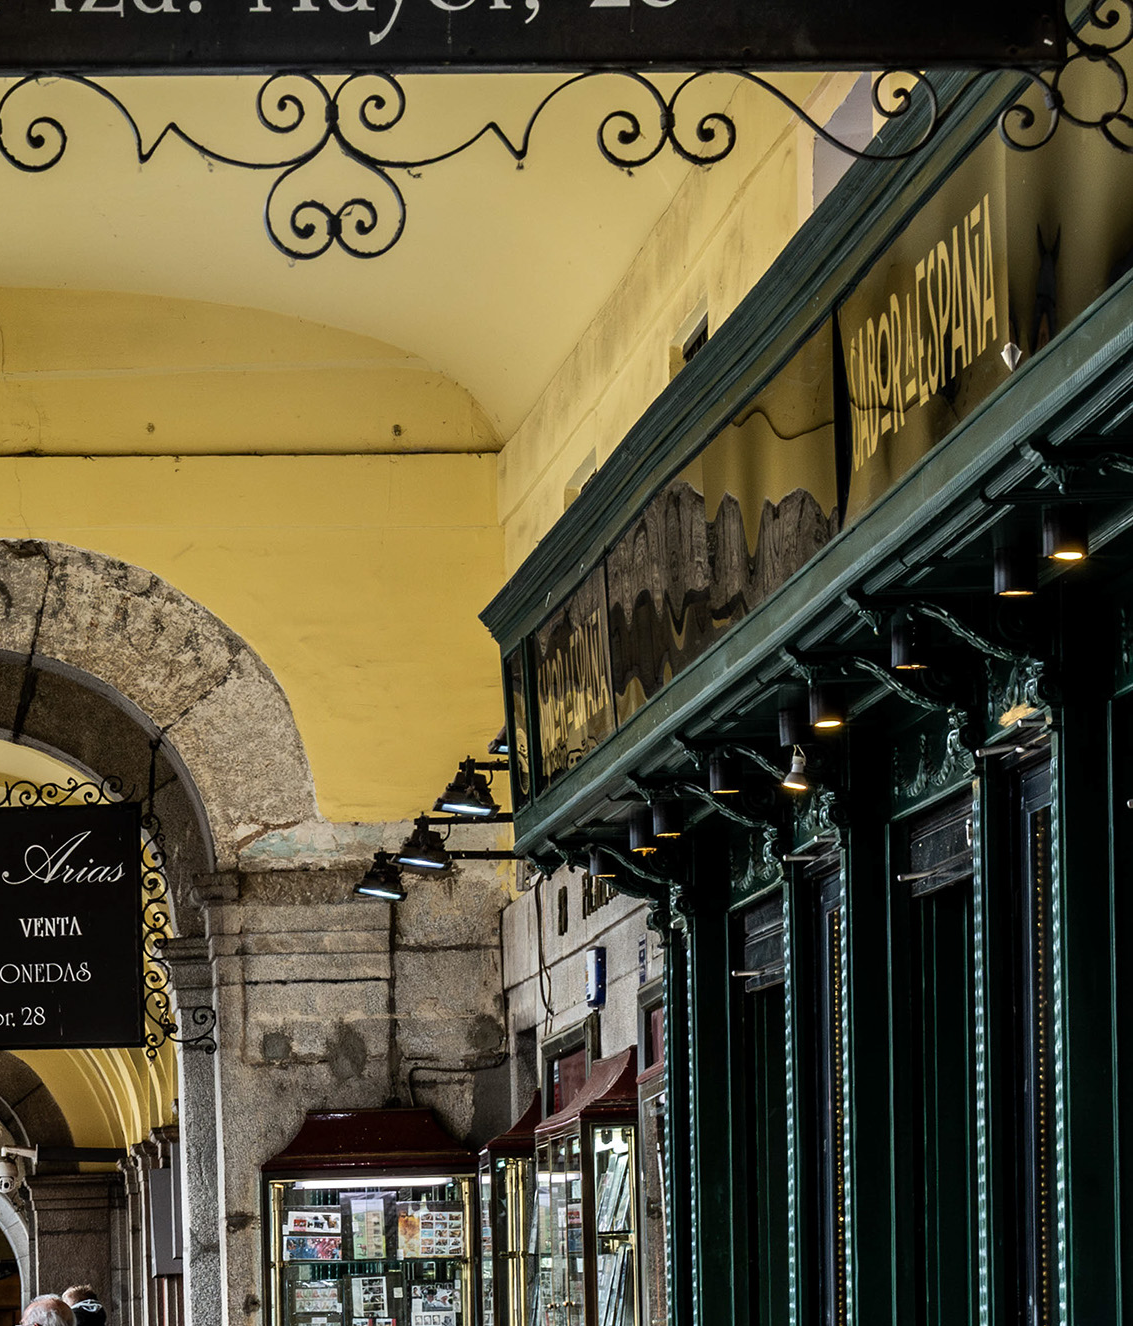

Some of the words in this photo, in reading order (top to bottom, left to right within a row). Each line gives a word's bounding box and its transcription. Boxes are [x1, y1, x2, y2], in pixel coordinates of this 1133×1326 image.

[850, 293, 905, 472] SABOR
[915, 193, 997, 407] ESPAÑA
[2, 831, 125, 885] Arias
[19, 916, 82, 937] VENTA
[21, 1007, 46, 1026] 28
